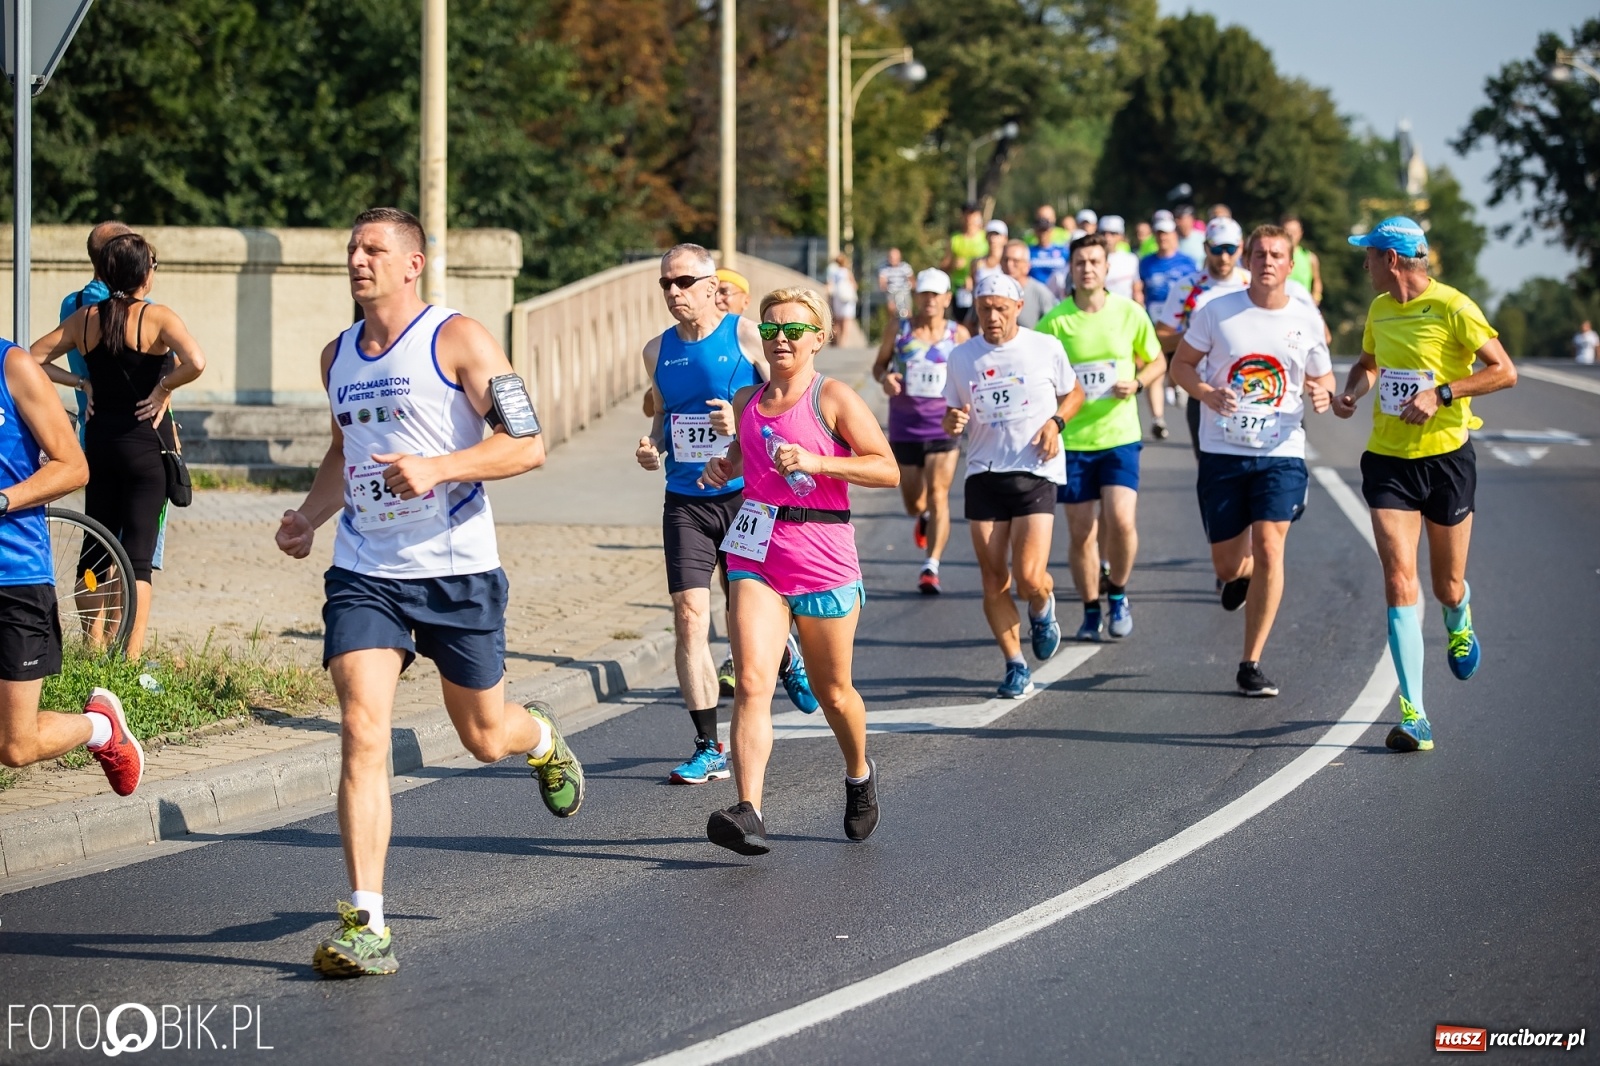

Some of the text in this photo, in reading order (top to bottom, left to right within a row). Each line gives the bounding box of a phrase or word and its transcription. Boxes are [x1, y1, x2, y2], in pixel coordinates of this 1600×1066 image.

[1083, 372, 1106, 385] 178
[337, 377, 410, 404] V PÓŁMARATON
[348, 391, 375, 402] KIETRZ
[380, 388, 411, 398] ROHOV
[1392, 382, 1419, 397] 392
[992, 390, 1010, 405] 95
[1240, 415, 1267, 431] 377
[688, 427, 717, 443] 375
[735, 513, 758, 536] 261
